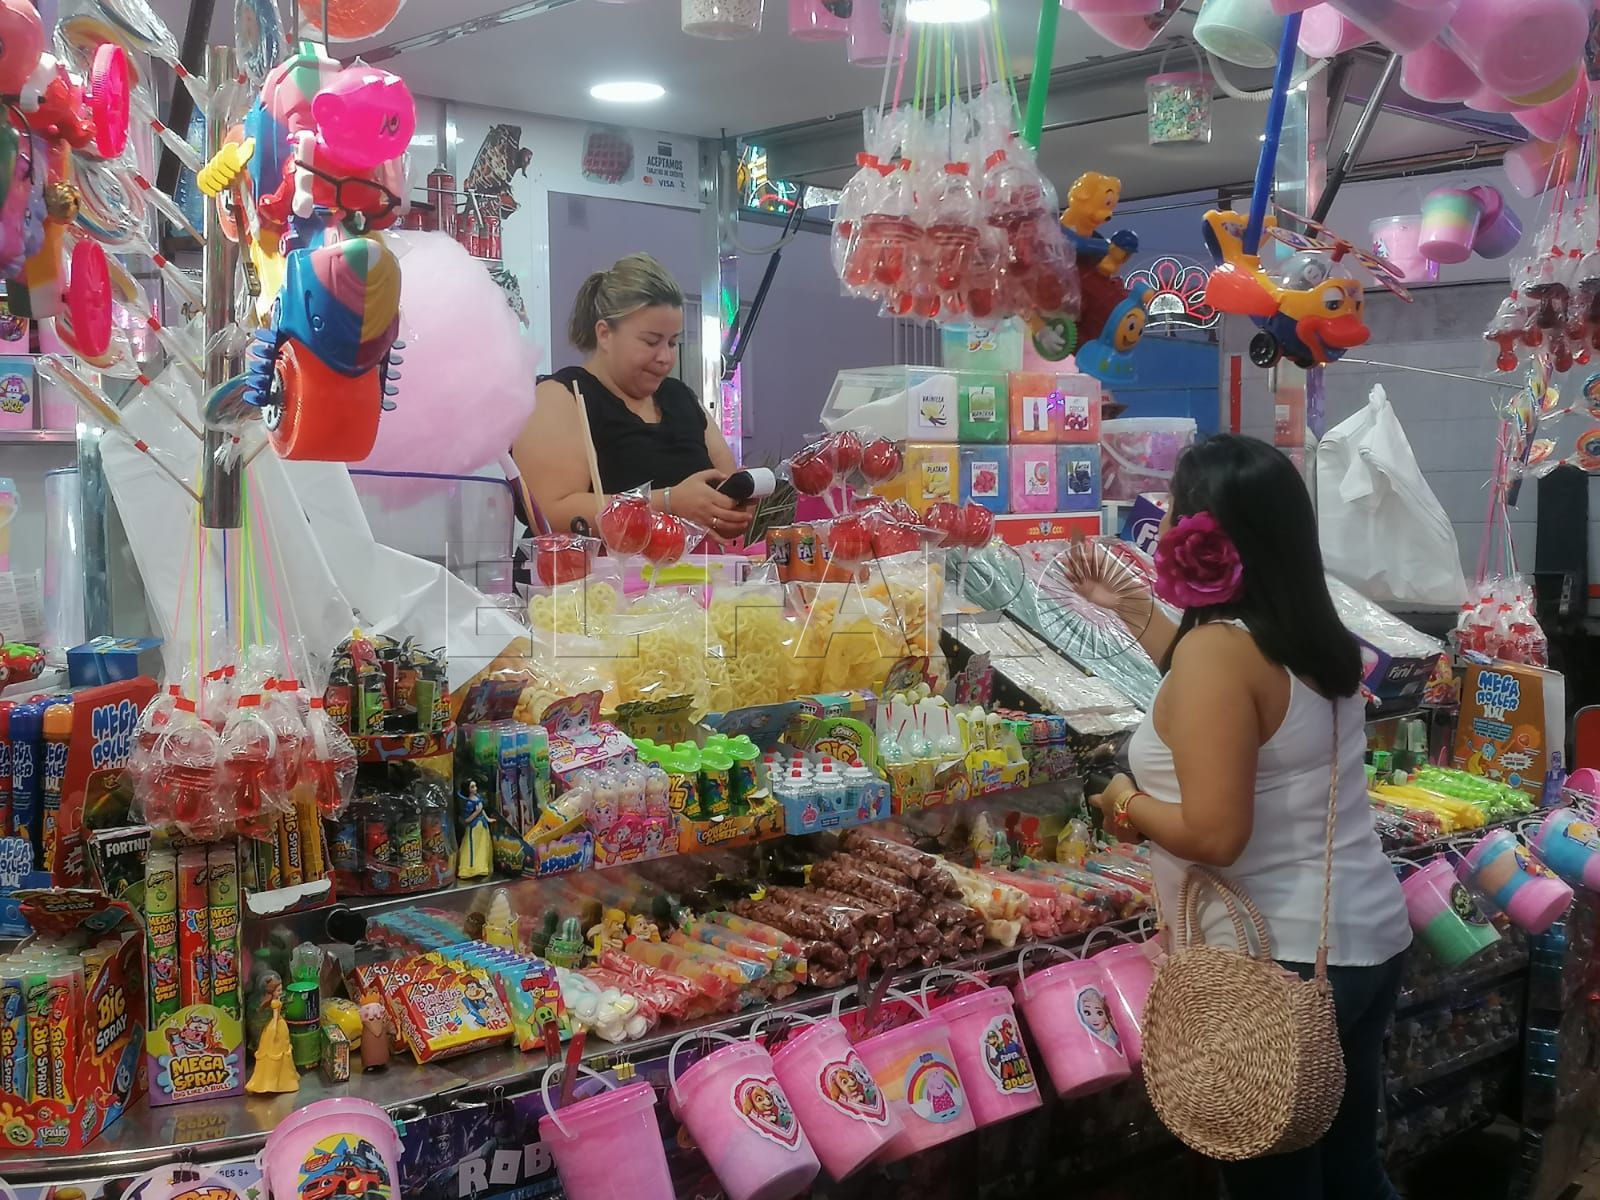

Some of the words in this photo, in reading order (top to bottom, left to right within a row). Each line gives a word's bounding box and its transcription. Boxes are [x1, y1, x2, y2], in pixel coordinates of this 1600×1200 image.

[647, 156, 683, 171] ACEPTAMOS
[658, 180, 675, 188] VISA
[1136, 522, 1160, 557] Fi
[1478, 671, 1520, 697] MEGA
[1476, 691, 1520, 711] ROLLER
[92, 700, 139, 739] MEGA
[92, 735, 132, 769] ROLLE
[106, 838, 151, 858] FORTNIT
[0, 857, 32, 877] OLLER
[396, 973, 411, 986] 50
[419, 983, 434, 996] 50
[95, 1013, 129, 1055] SPRAY
[2, 1056, 15, 1095] SPRAY
[34, 1056, 50, 1098] SPRAY
[170, 1055, 225, 1078] MEGA
[1001, 1059, 1028, 1079] MAR
[53, 1059, 66, 1100] SPRAY
[173, 1070, 230, 1091] SPRAY
[187, 1088, 203, 1096] LIKE
[38, 1127, 70, 1139] LIQUID
[458, 1141, 552, 1198] ROB
